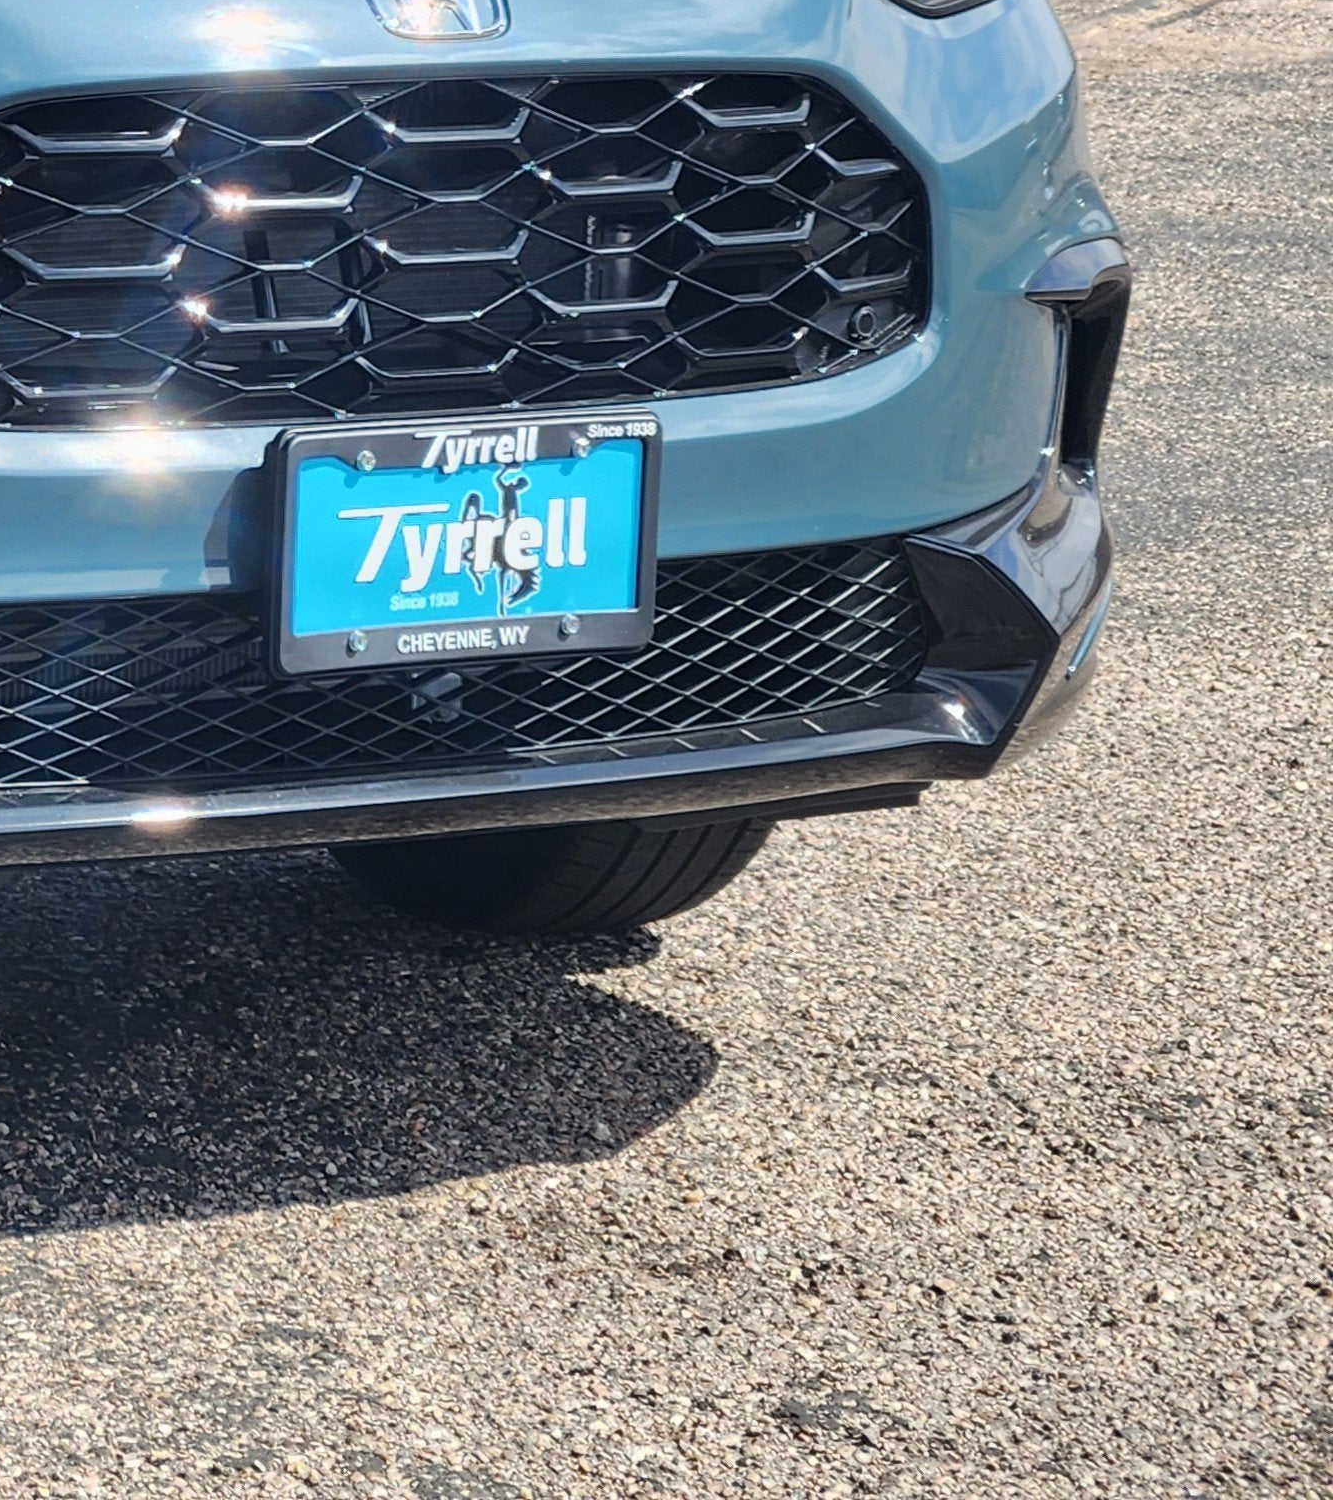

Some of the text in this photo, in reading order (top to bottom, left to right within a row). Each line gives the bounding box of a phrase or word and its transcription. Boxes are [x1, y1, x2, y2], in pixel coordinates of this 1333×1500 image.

[587, 422, 657, 438] Since 1938
[414, 426, 539, 474] Tyrrell
[337, 496, 588, 592] Tyrrell
[389, 591, 459, 611] Since 1938
[397, 625, 531, 654] CHEYENNE, WY
